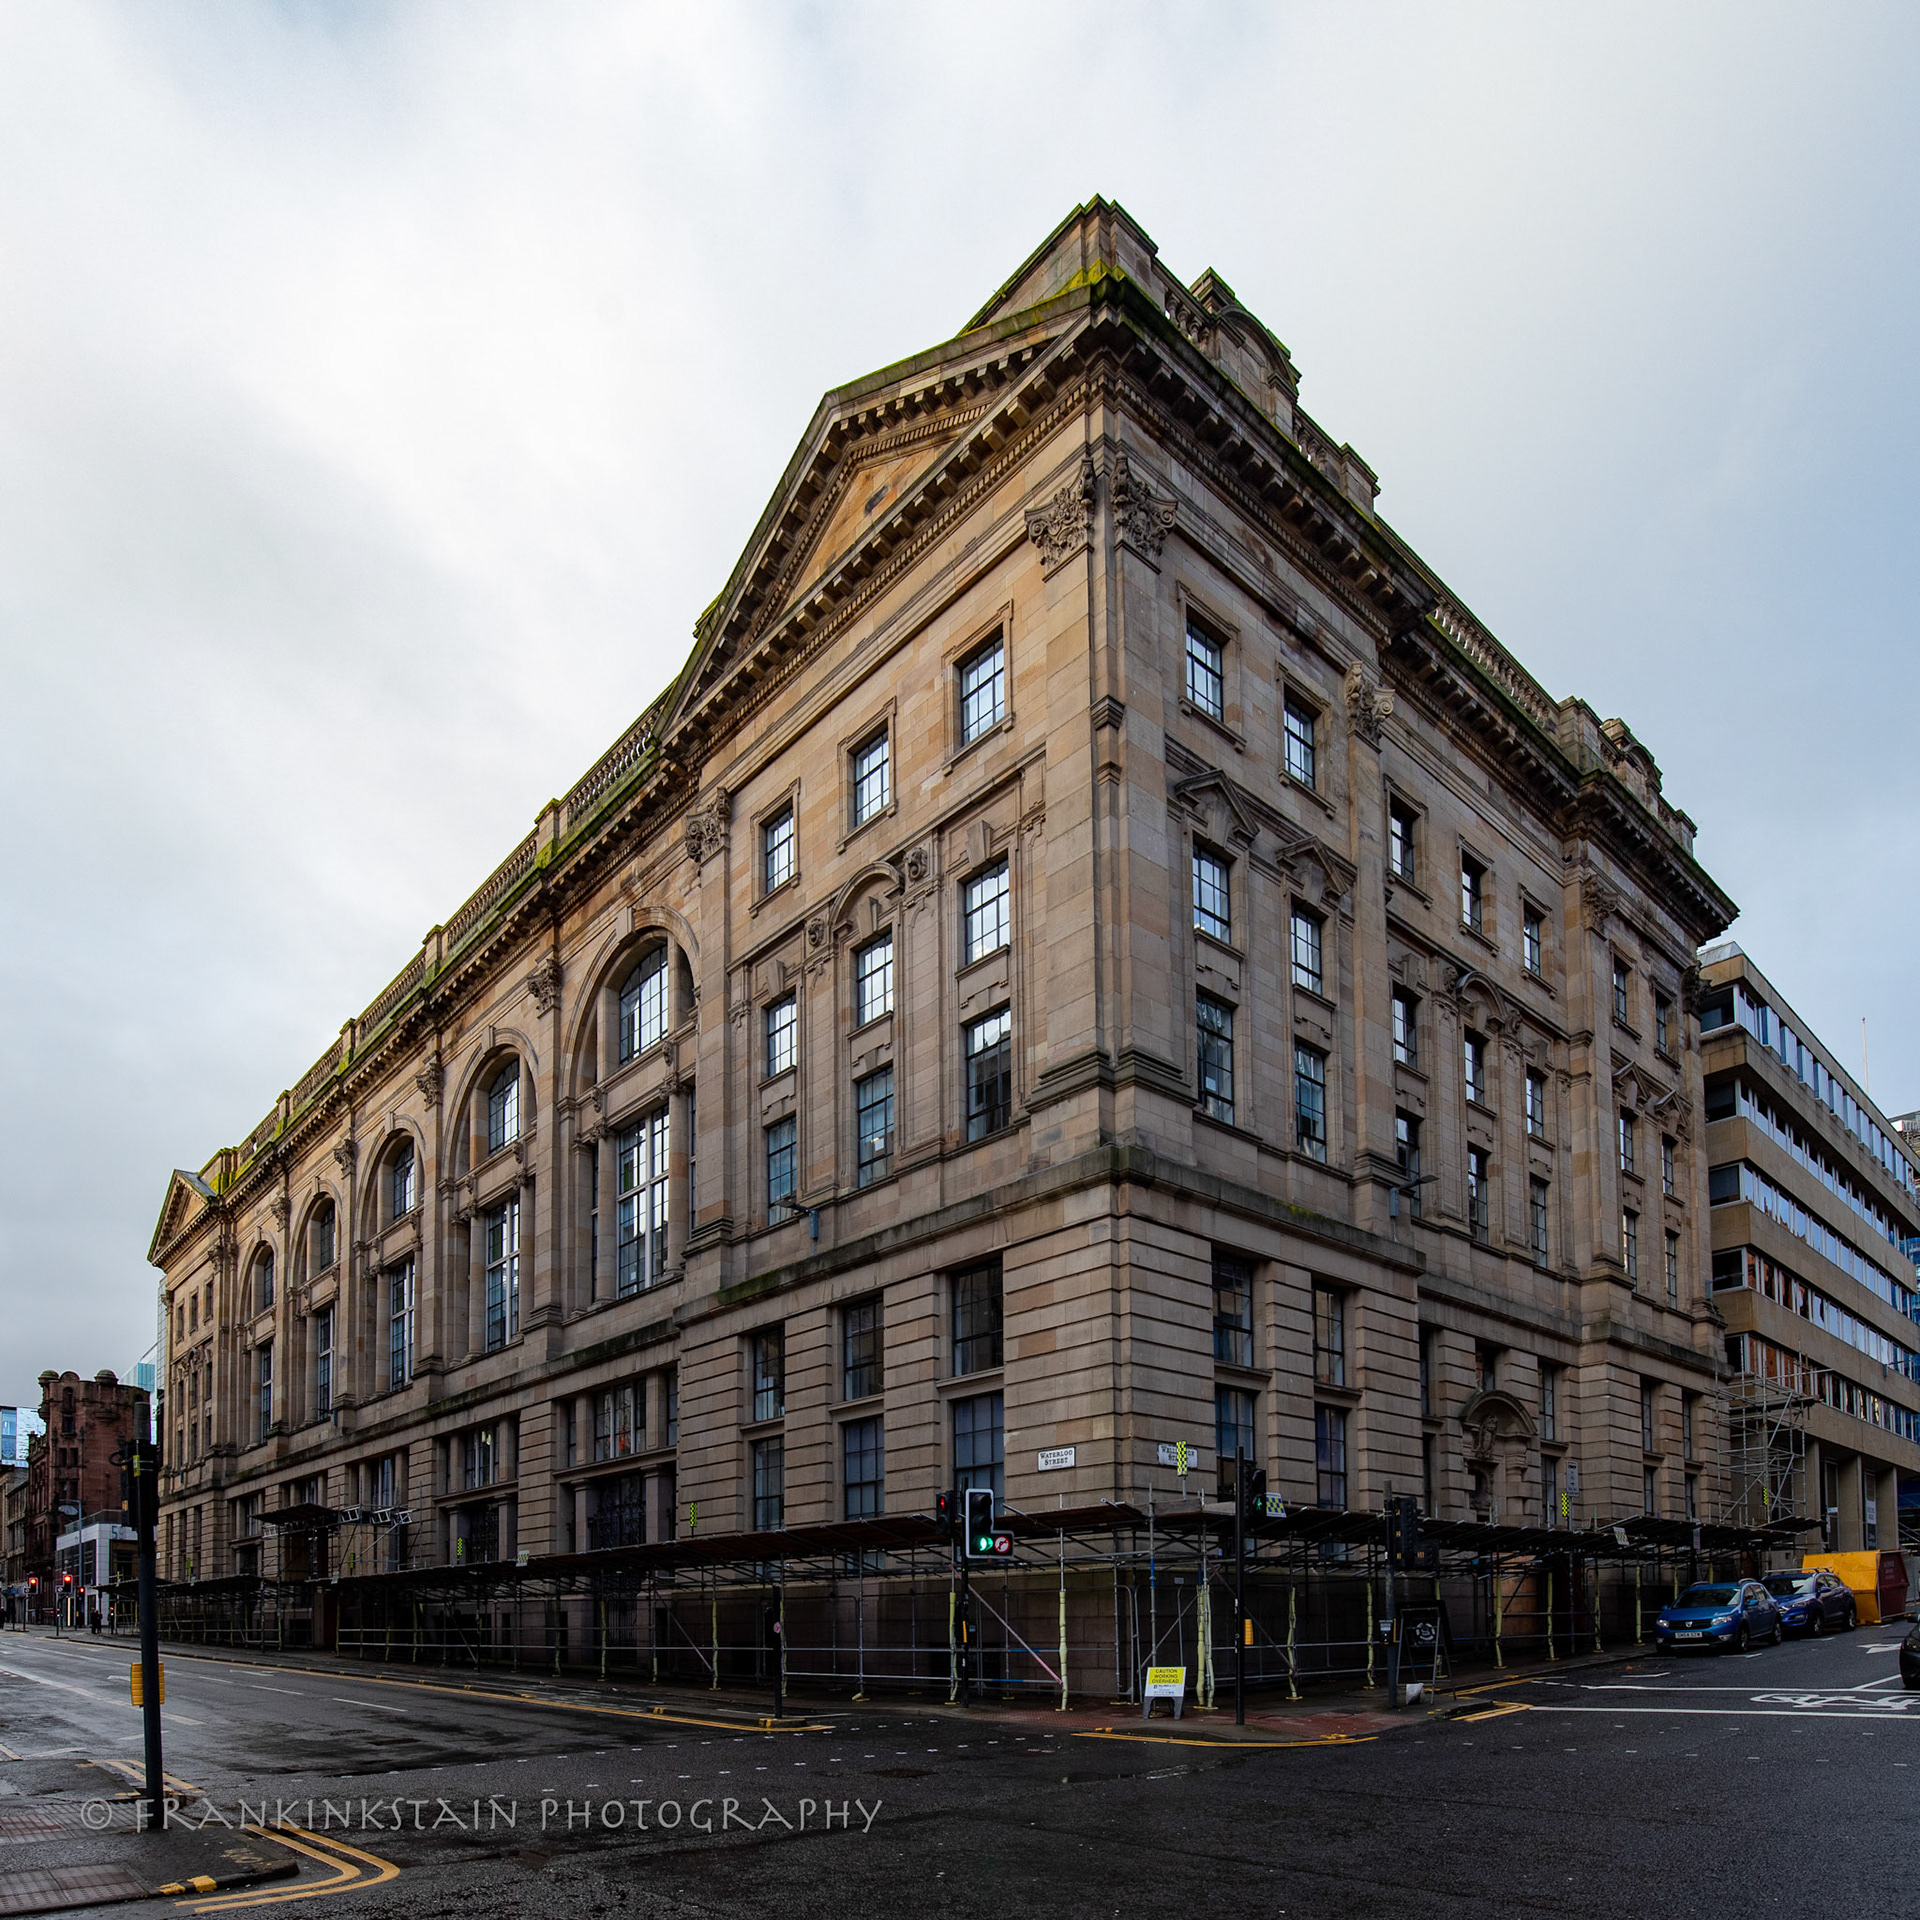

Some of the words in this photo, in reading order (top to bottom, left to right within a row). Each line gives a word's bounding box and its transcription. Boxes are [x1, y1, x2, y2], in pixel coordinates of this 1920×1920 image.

[1040, 1450, 1073, 1459] WATERLOO
[1161, 1446, 1194, 1456] WELLON
[1044, 1457, 1068, 1466] STREET
